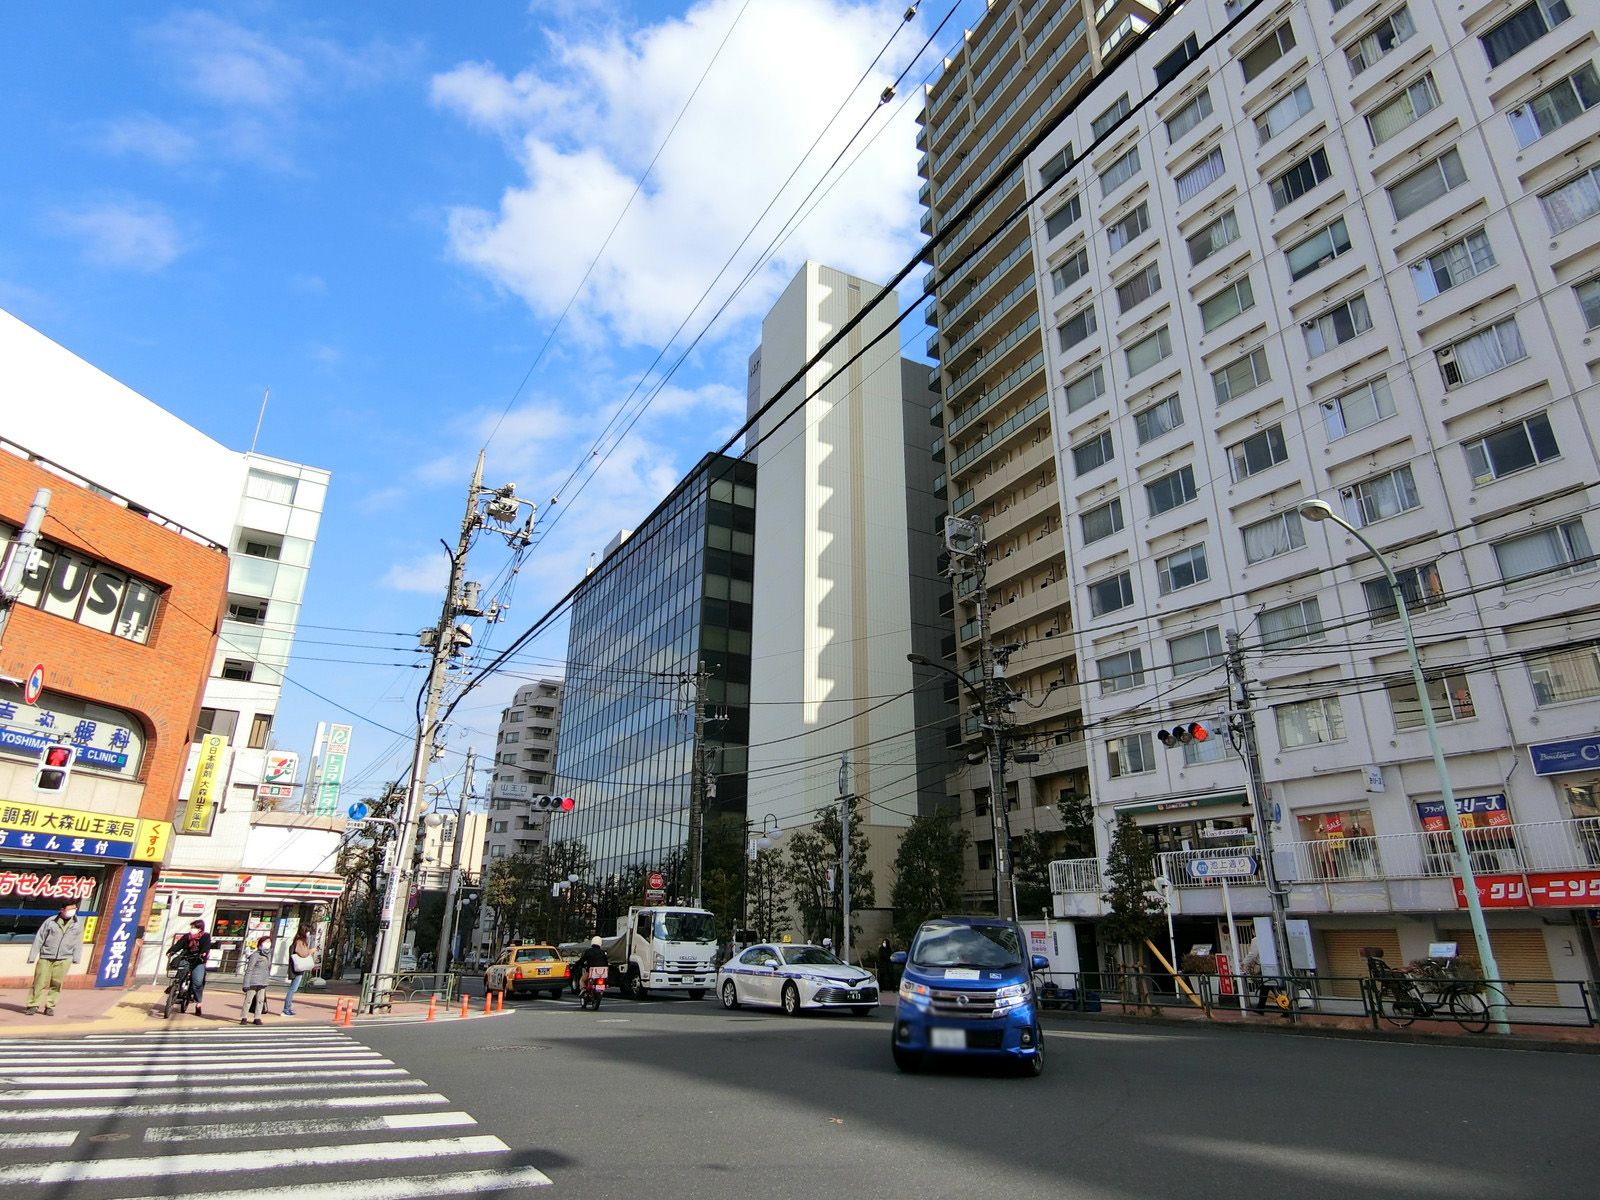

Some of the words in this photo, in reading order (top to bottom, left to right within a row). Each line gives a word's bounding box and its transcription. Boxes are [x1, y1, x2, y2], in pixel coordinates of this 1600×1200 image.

[88, 750, 117, 763] CLINIC
[1540, 751, 1576, 761] Boutique
[203, 747, 217, 778] 日本調剤
[501, 784, 527, 793] 山王口
[190, 781, 209, 829] 大森山王薬局
[0, 807, 38, 826] 調剤
[41, 812, 135, 838] 大森山王薬局
[1327, 820, 1341, 831] SALE
[1426, 819, 1443, 831] SALE
[1489, 814, 1508, 826] SALE
[146, 824, 161, 857] くすり
[1210, 859, 1246, 870] 池上通り
[105, 869, 144, 979] 処方せん受付
